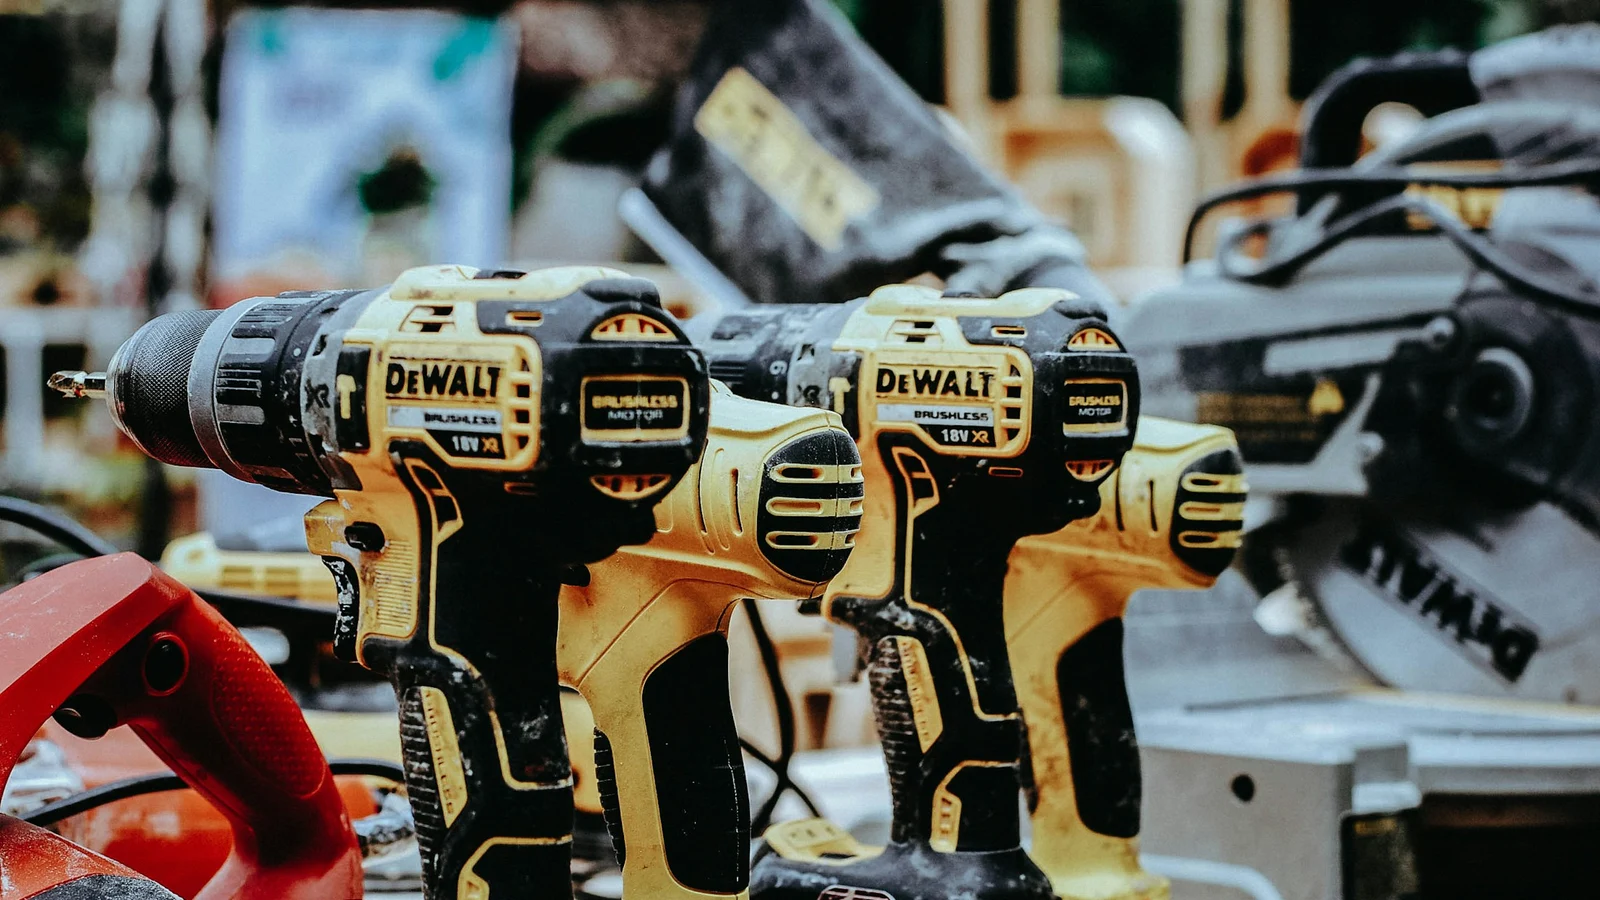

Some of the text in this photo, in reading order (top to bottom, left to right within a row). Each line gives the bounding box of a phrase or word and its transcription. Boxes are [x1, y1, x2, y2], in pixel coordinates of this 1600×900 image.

[1069, 395, 1121, 406] BRUSHLESS
[607, 409, 664, 421] MOTOR
[914, 410, 990, 421] BRUSHLESS
[941, 429, 990, 444] 18V XR
[452, 435, 479, 452] 18V
